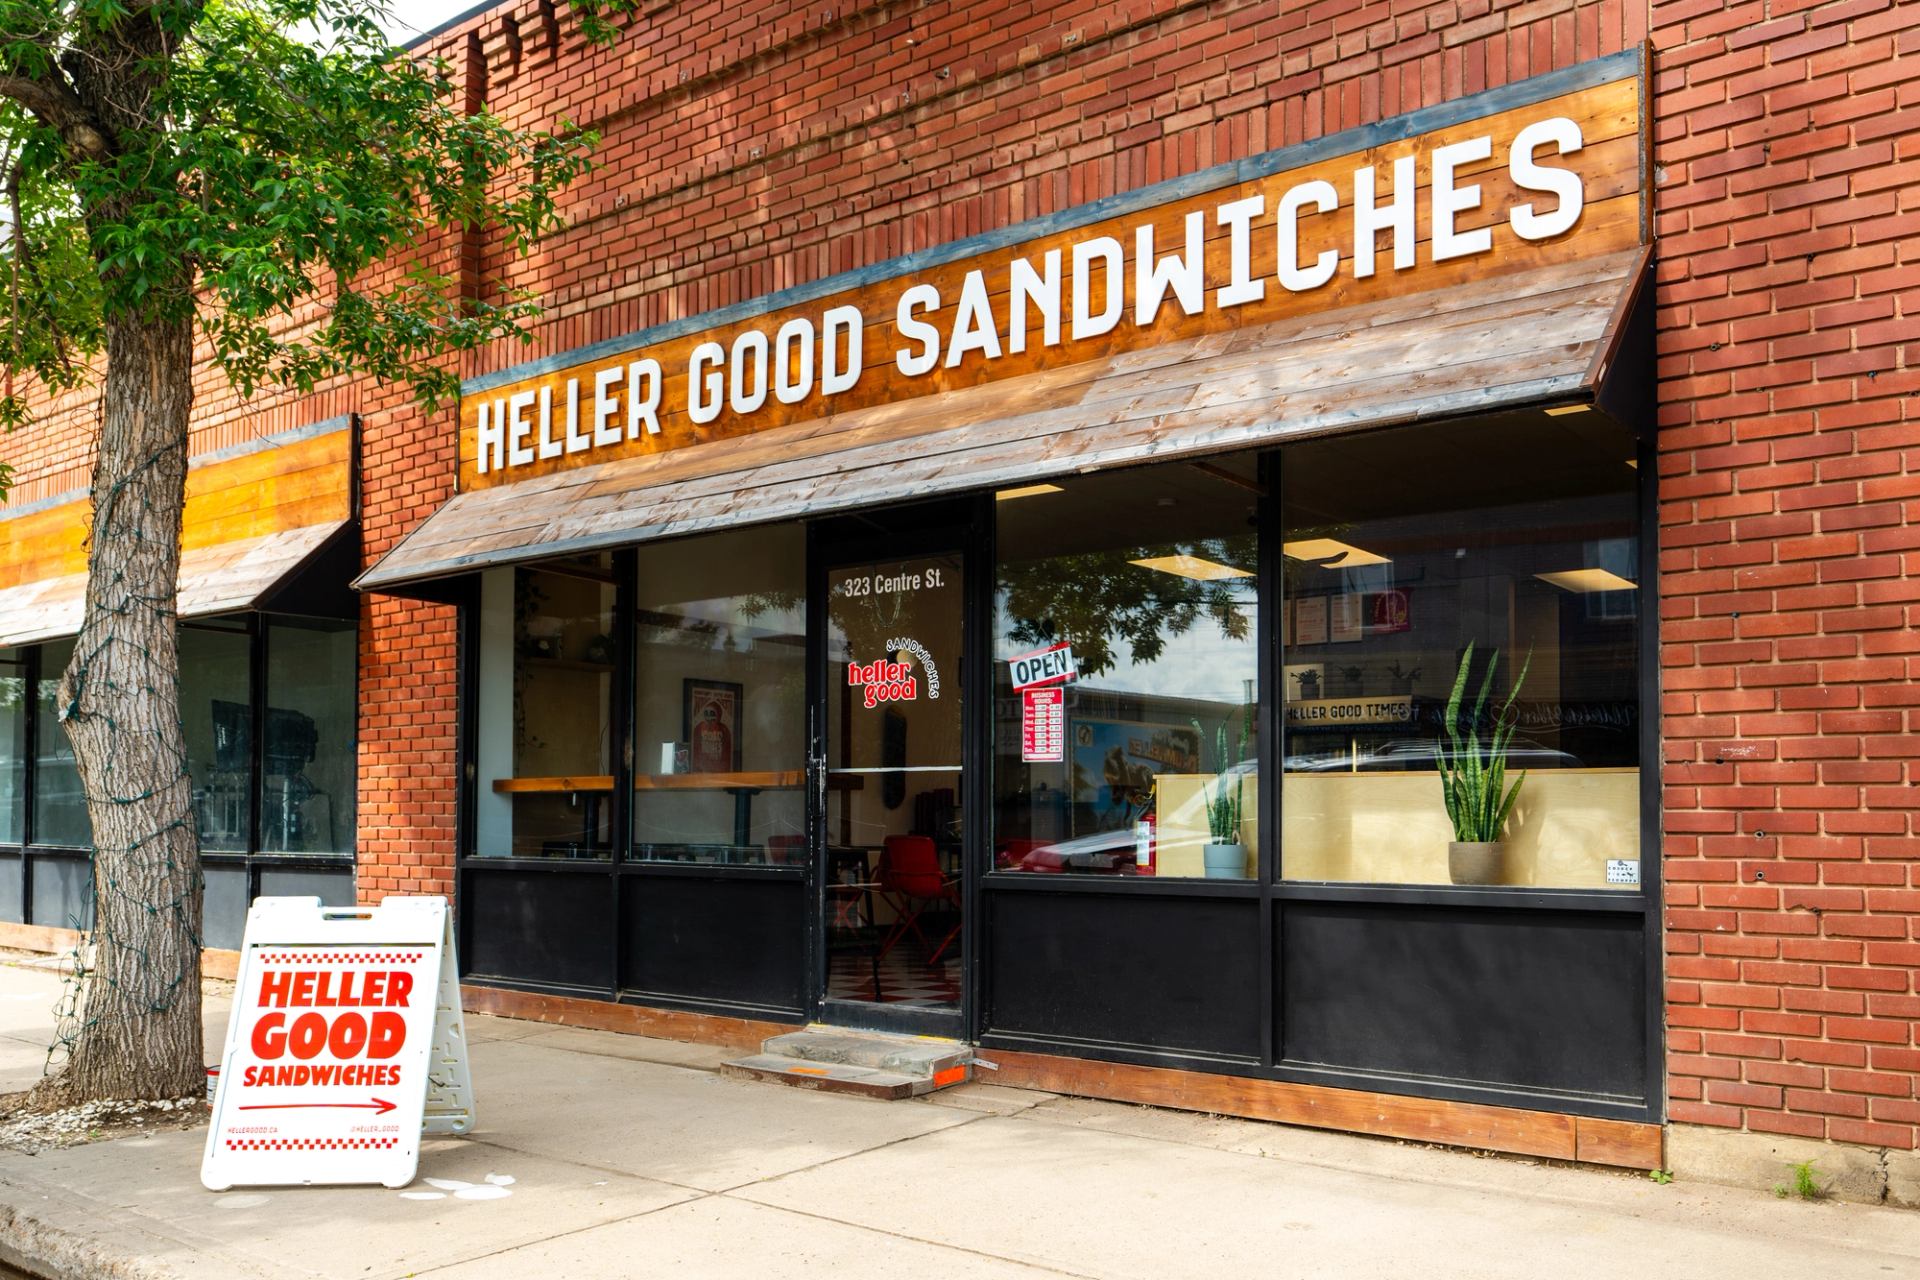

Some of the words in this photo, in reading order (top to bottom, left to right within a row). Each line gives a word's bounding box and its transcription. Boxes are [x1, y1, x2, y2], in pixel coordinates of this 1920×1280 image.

[477, 358, 662, 474] HELLER
[688, 304, 864, 425] GOOD
[896, 116, 1584, 377] SANDWICHES
[845, 576, 871, 598] 323
[874, 572, 922, 595] Centre
[925, 568, 946, 589] St.
[848, 659, 912, 686] heller
[886, 637, 940, 700] SANDWICHES
[1016, 650, 1068, 685] OPEN
[864, 676, 917, 709] good
[1330, 704, 1361, 718] GOOD
[1366, 702, 1407, 717] TIMES
[257, 971, 414, 1008] HELLER
[250, 1011, 407, 1061] GOOD
[243, 1065, 402, 1088] SANDWICHES
